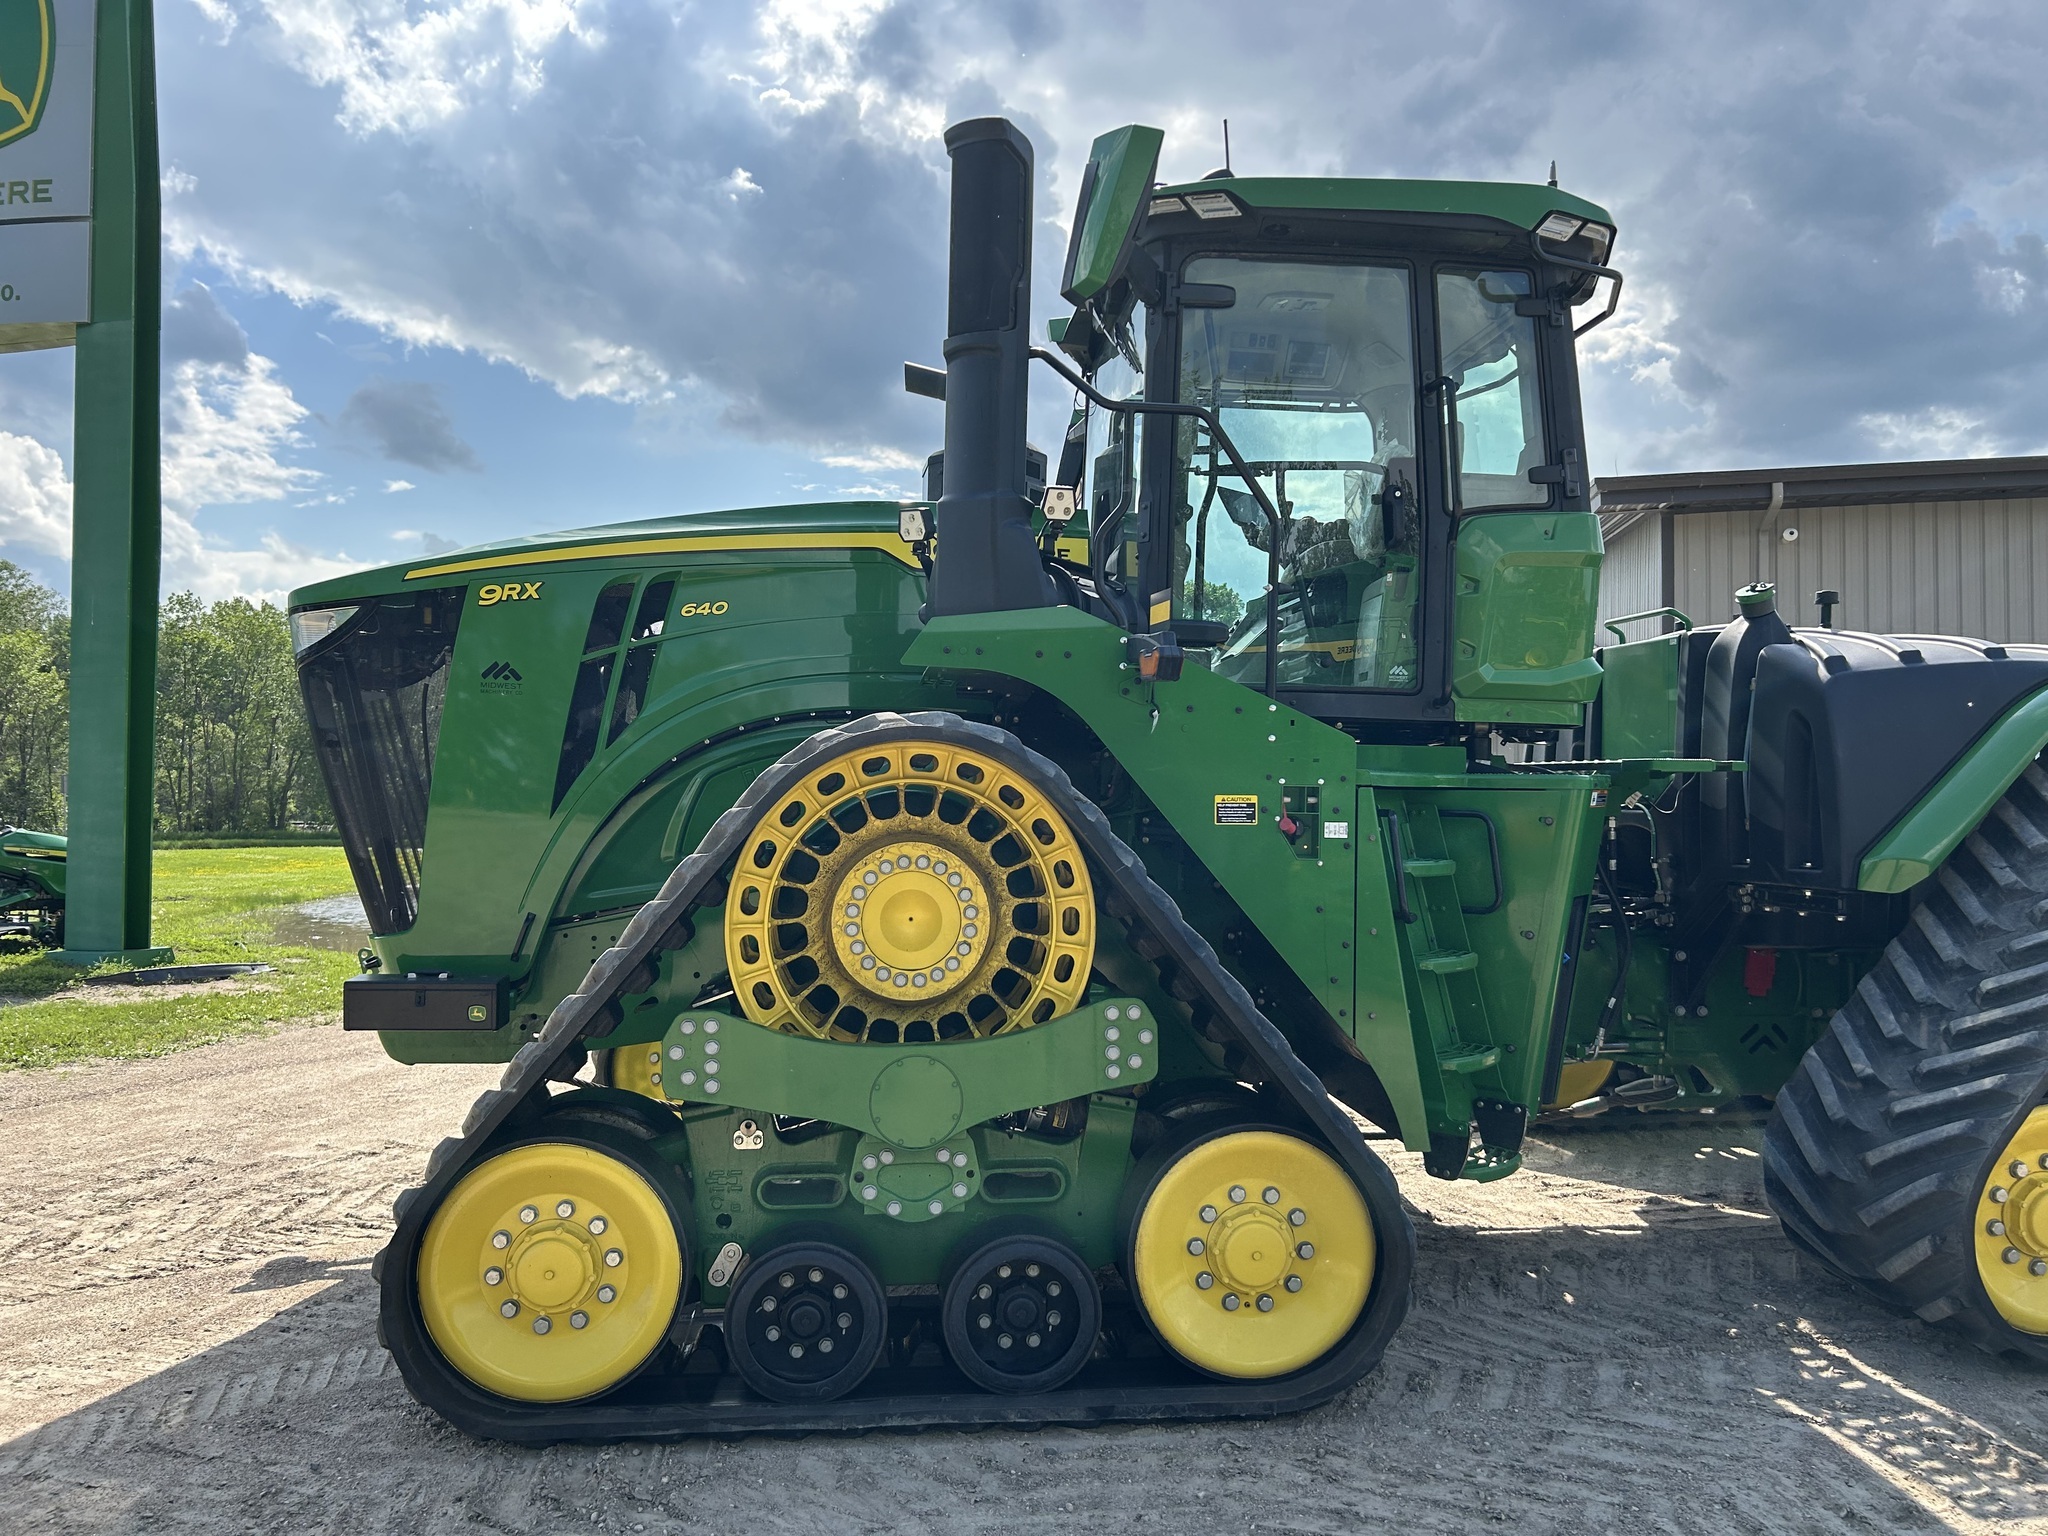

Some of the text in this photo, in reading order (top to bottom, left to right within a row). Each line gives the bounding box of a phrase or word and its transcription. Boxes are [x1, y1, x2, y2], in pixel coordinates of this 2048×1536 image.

[0, 179, 53, 205] RE
[478, 581, 543, 606] 9RX
[680, 600, 729, 617] 640
[480, 682, 523, 690] MIDWEST
